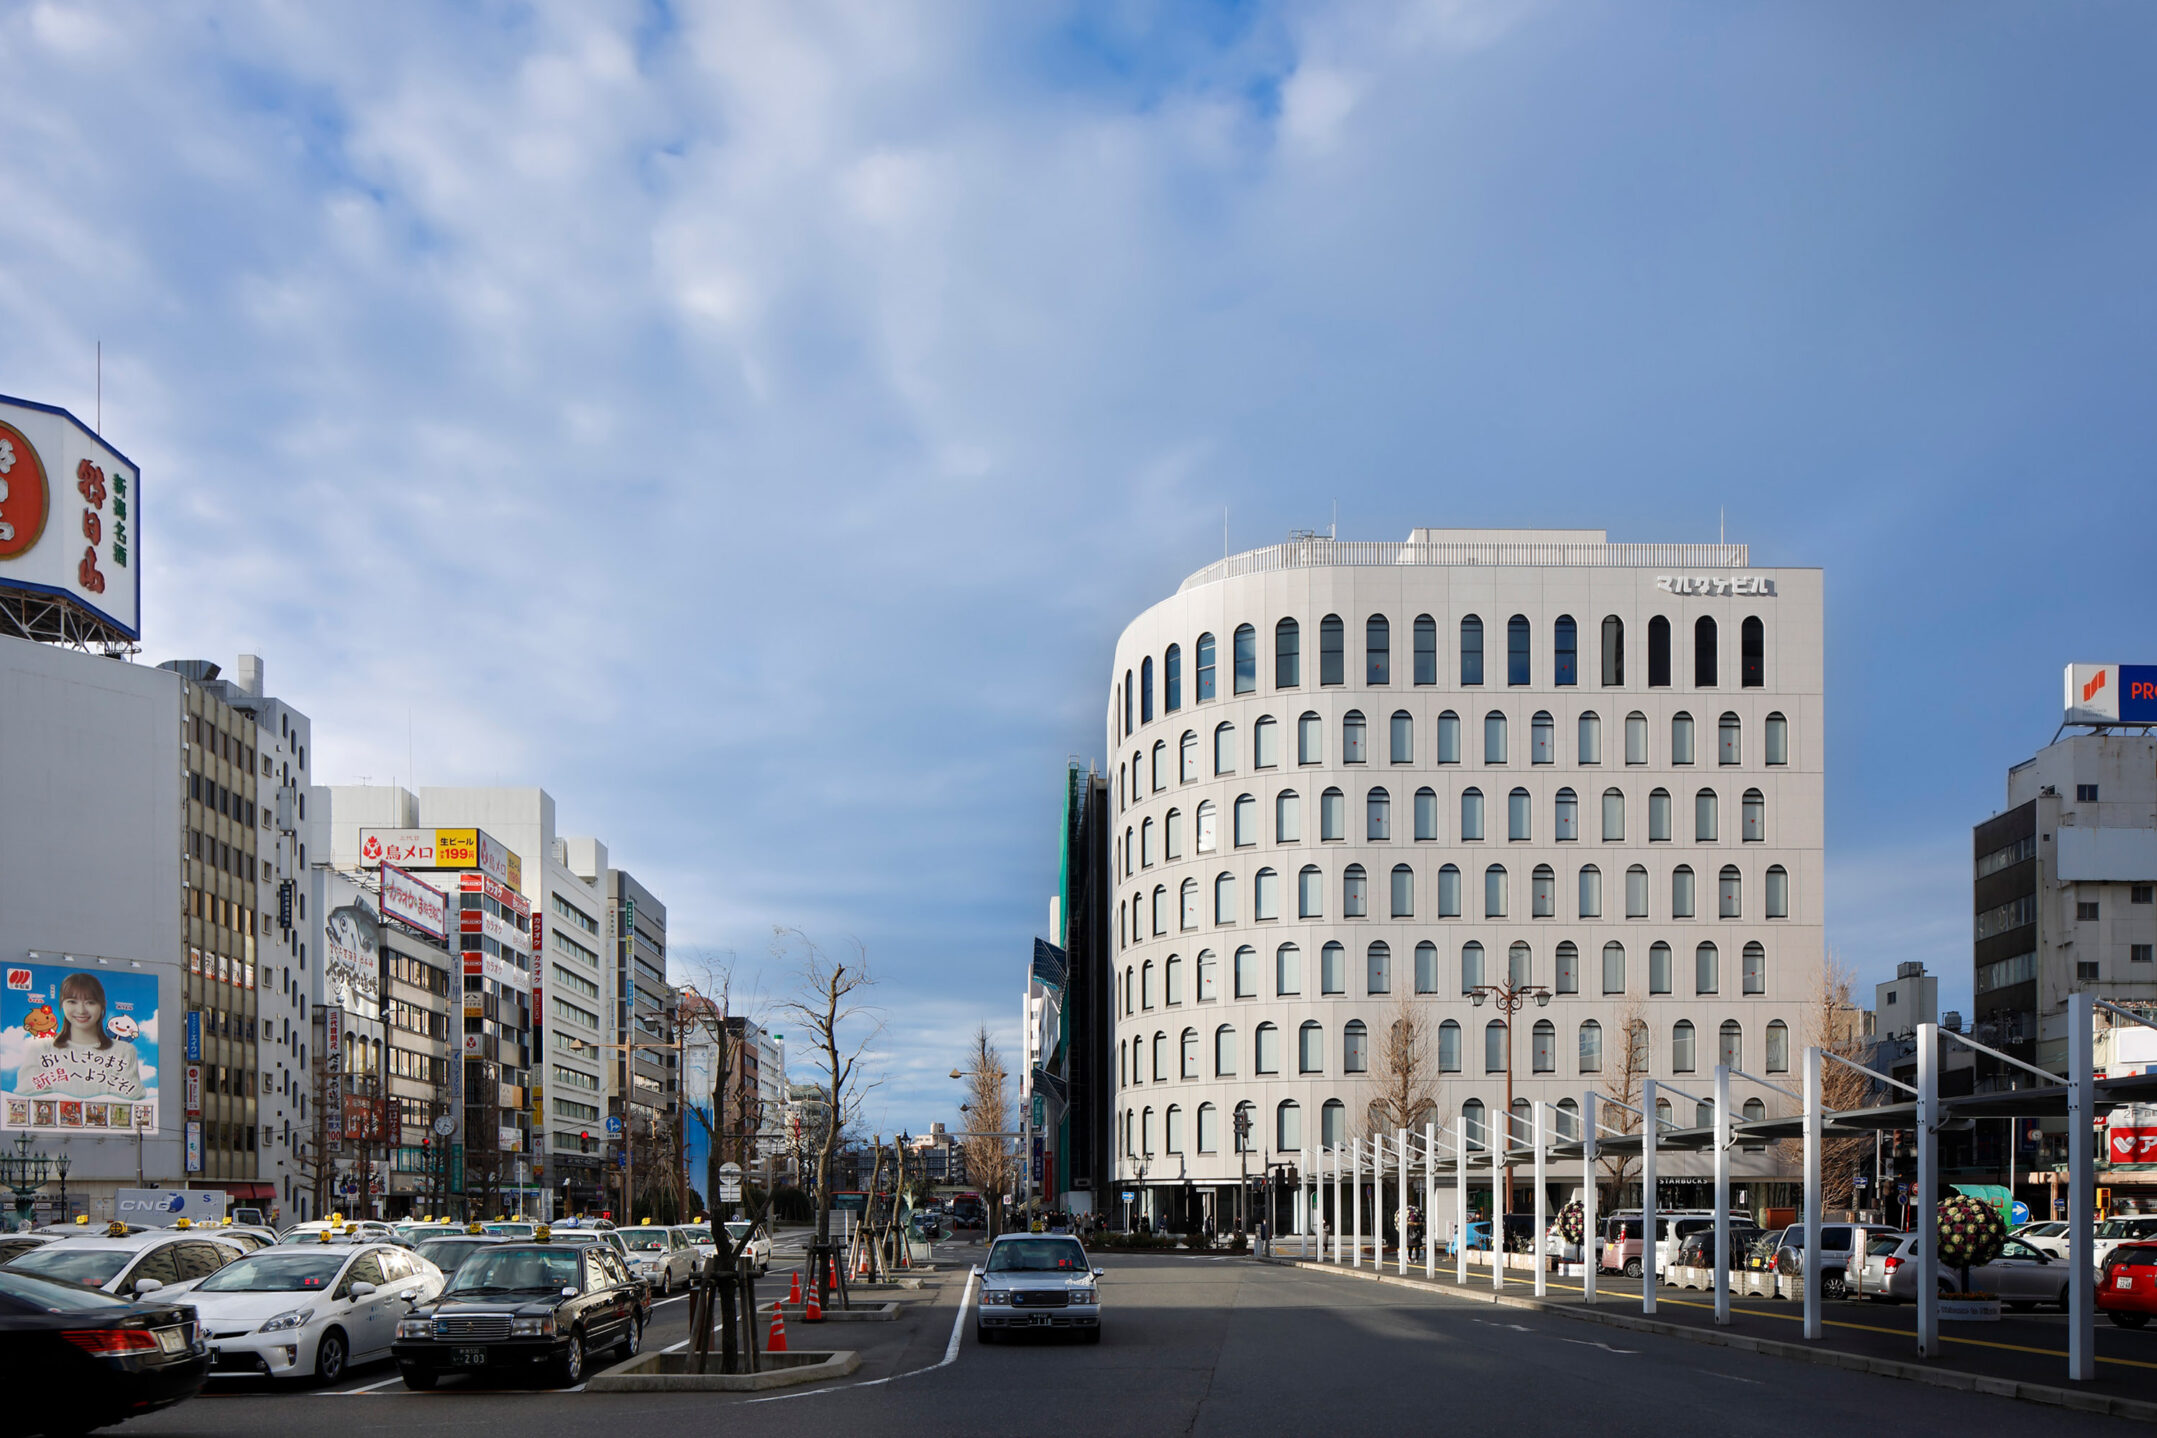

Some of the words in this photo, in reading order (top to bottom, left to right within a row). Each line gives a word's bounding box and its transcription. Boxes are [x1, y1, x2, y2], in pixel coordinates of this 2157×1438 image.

[113, 473, 127, 568] 新潟名酒
[1657, 575, 1769, 594] マルタケビル
[2131, 682, 2157, 700] PR
[440, 838, 474, 846] 生ビール
[386, 845, 433, 861] 鳥メロ
[485, 880, 503, 898] カラオケ
[485, 919, 503, 935] カラオケ
[486, 960, 503, 976] カラオケ
[534, 955, 542, 984] カラオケ
[41, 1051, 126, 1072] おいしさのまち
[32, 1068, 135, 1095] 新潟へようこそ!
[328, 1131, 341, 1140] 100
[1659, 1177, 1708, 1185] STARBUCKS
[119, 1200, 171, 1211] CNG
